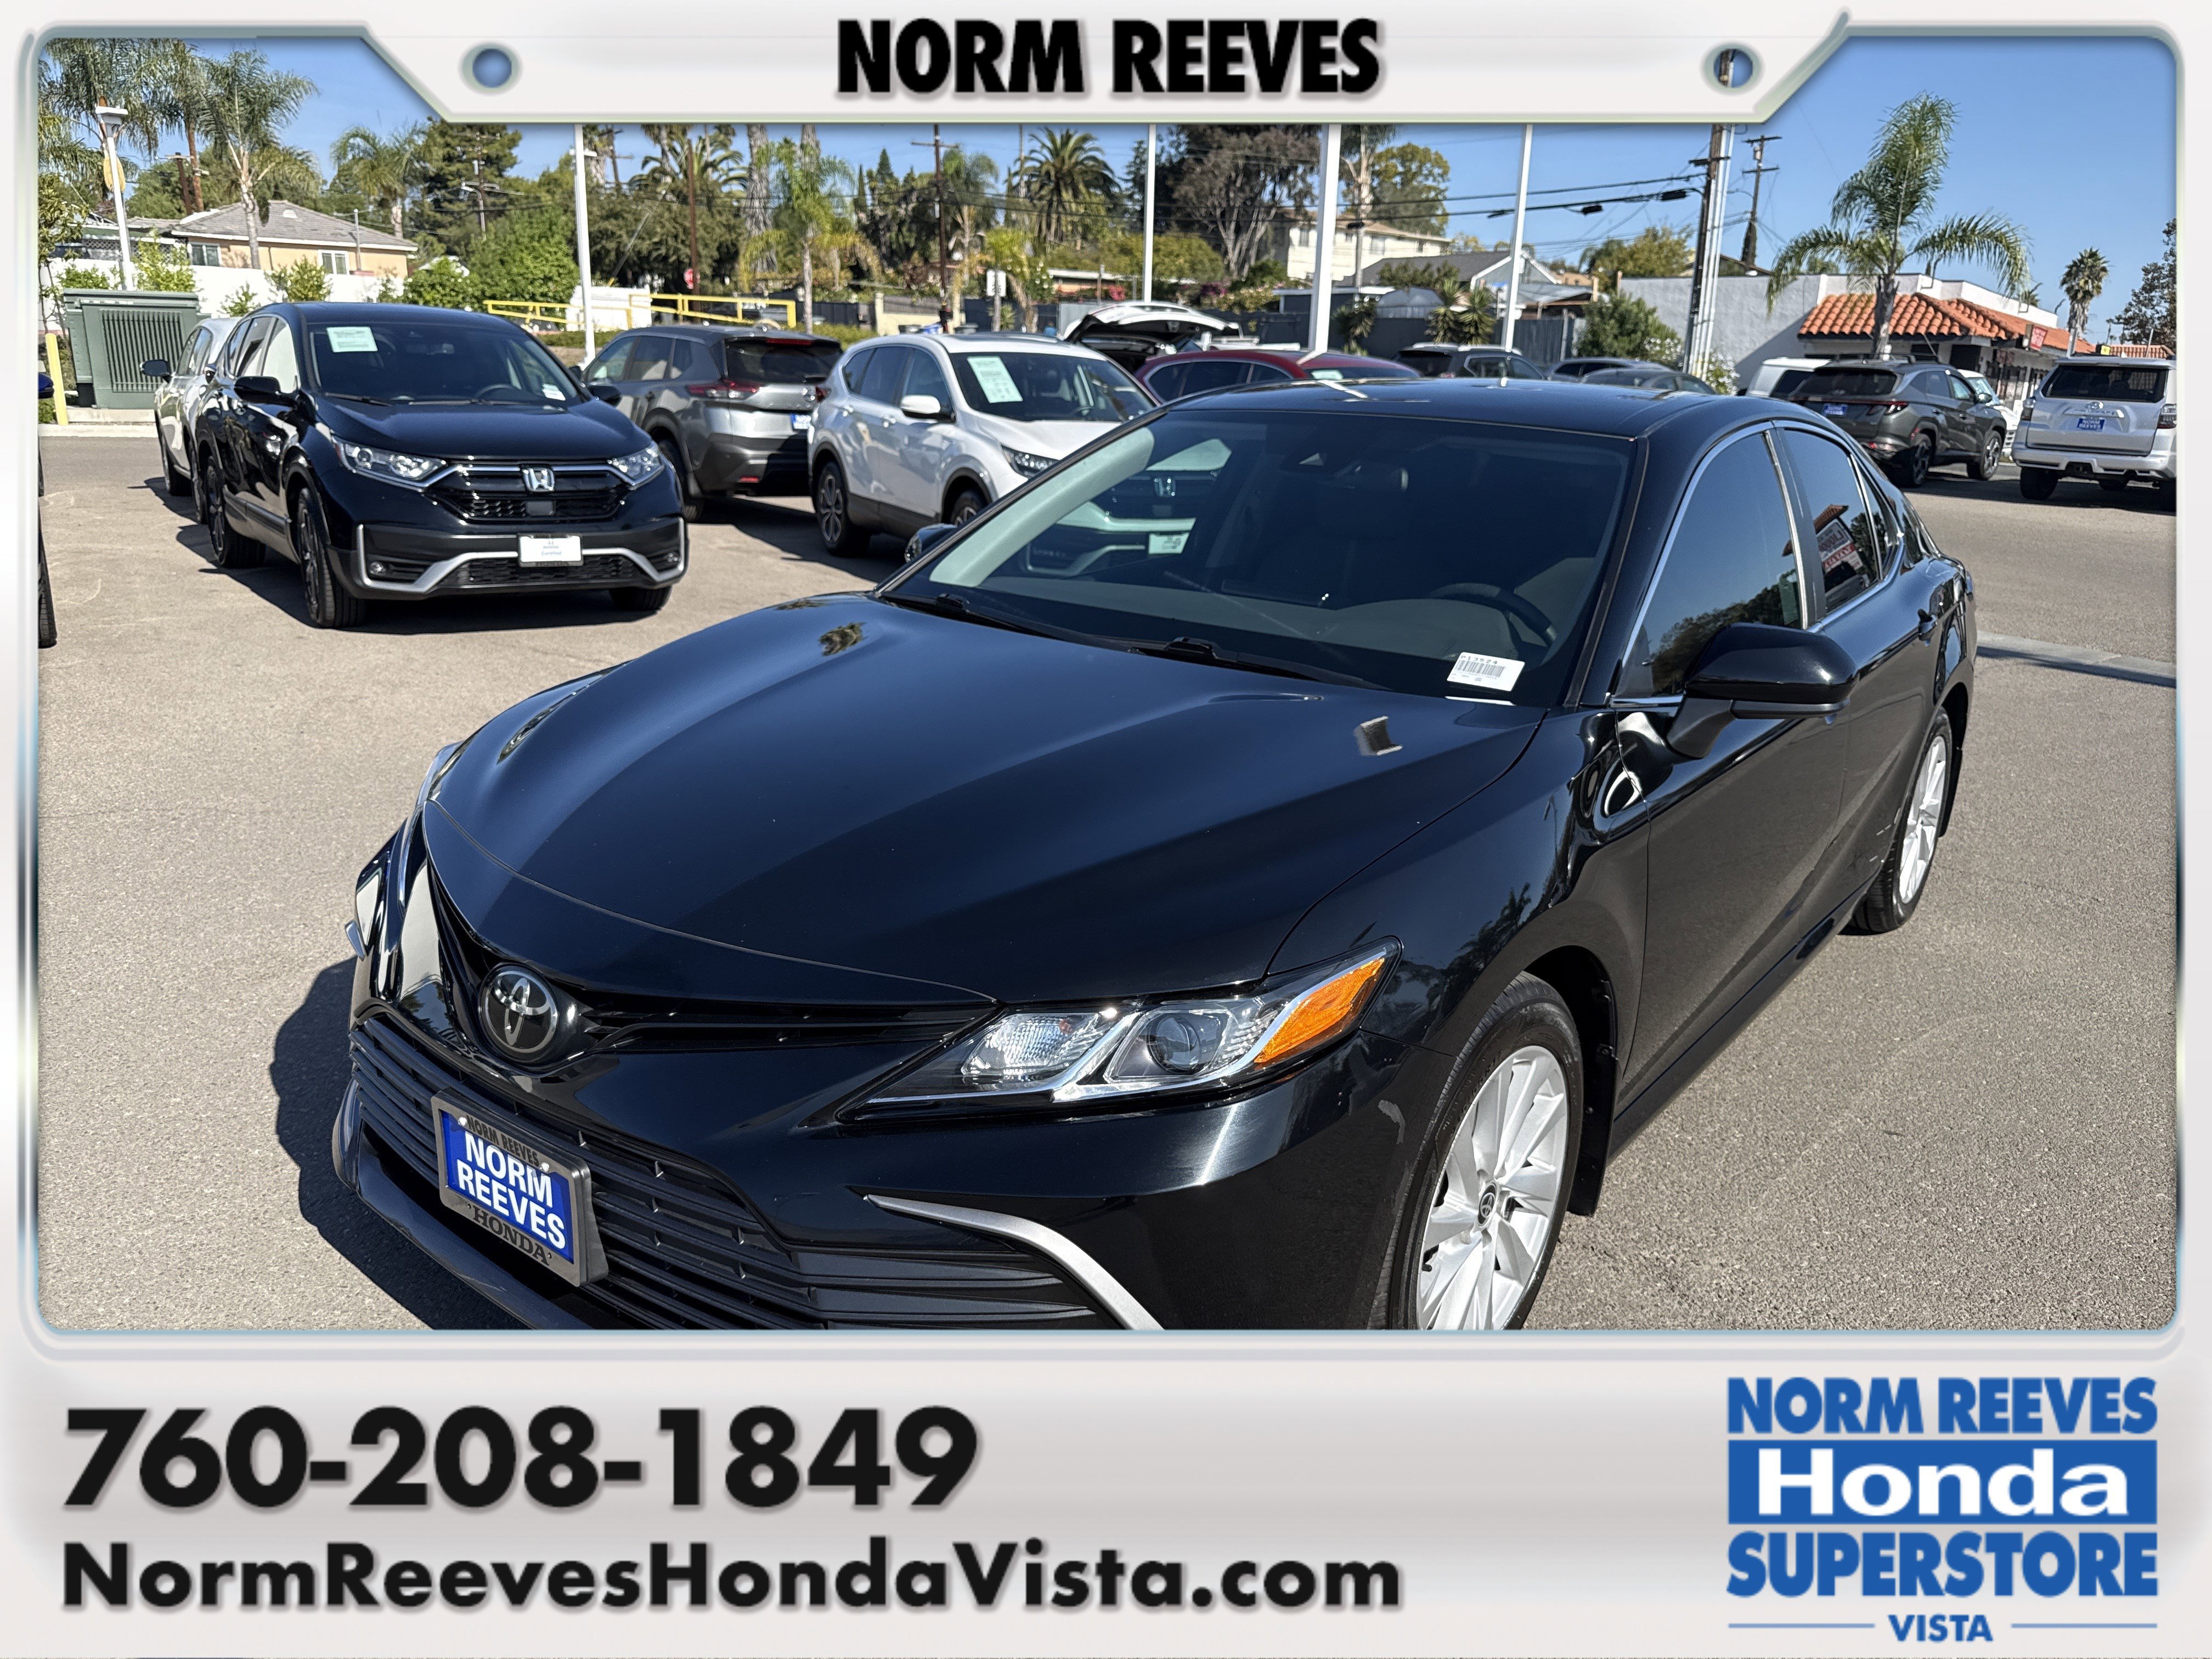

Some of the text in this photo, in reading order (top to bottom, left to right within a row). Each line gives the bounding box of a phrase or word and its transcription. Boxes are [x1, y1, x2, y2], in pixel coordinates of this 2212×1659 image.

[465, 1130, 553, 1208] NORM
[466, 1114, 540, 1167] NORM REEVES
[456, 1159, 566, 1250] REEVES
[472, 1205, 550, 1266] HONDA
